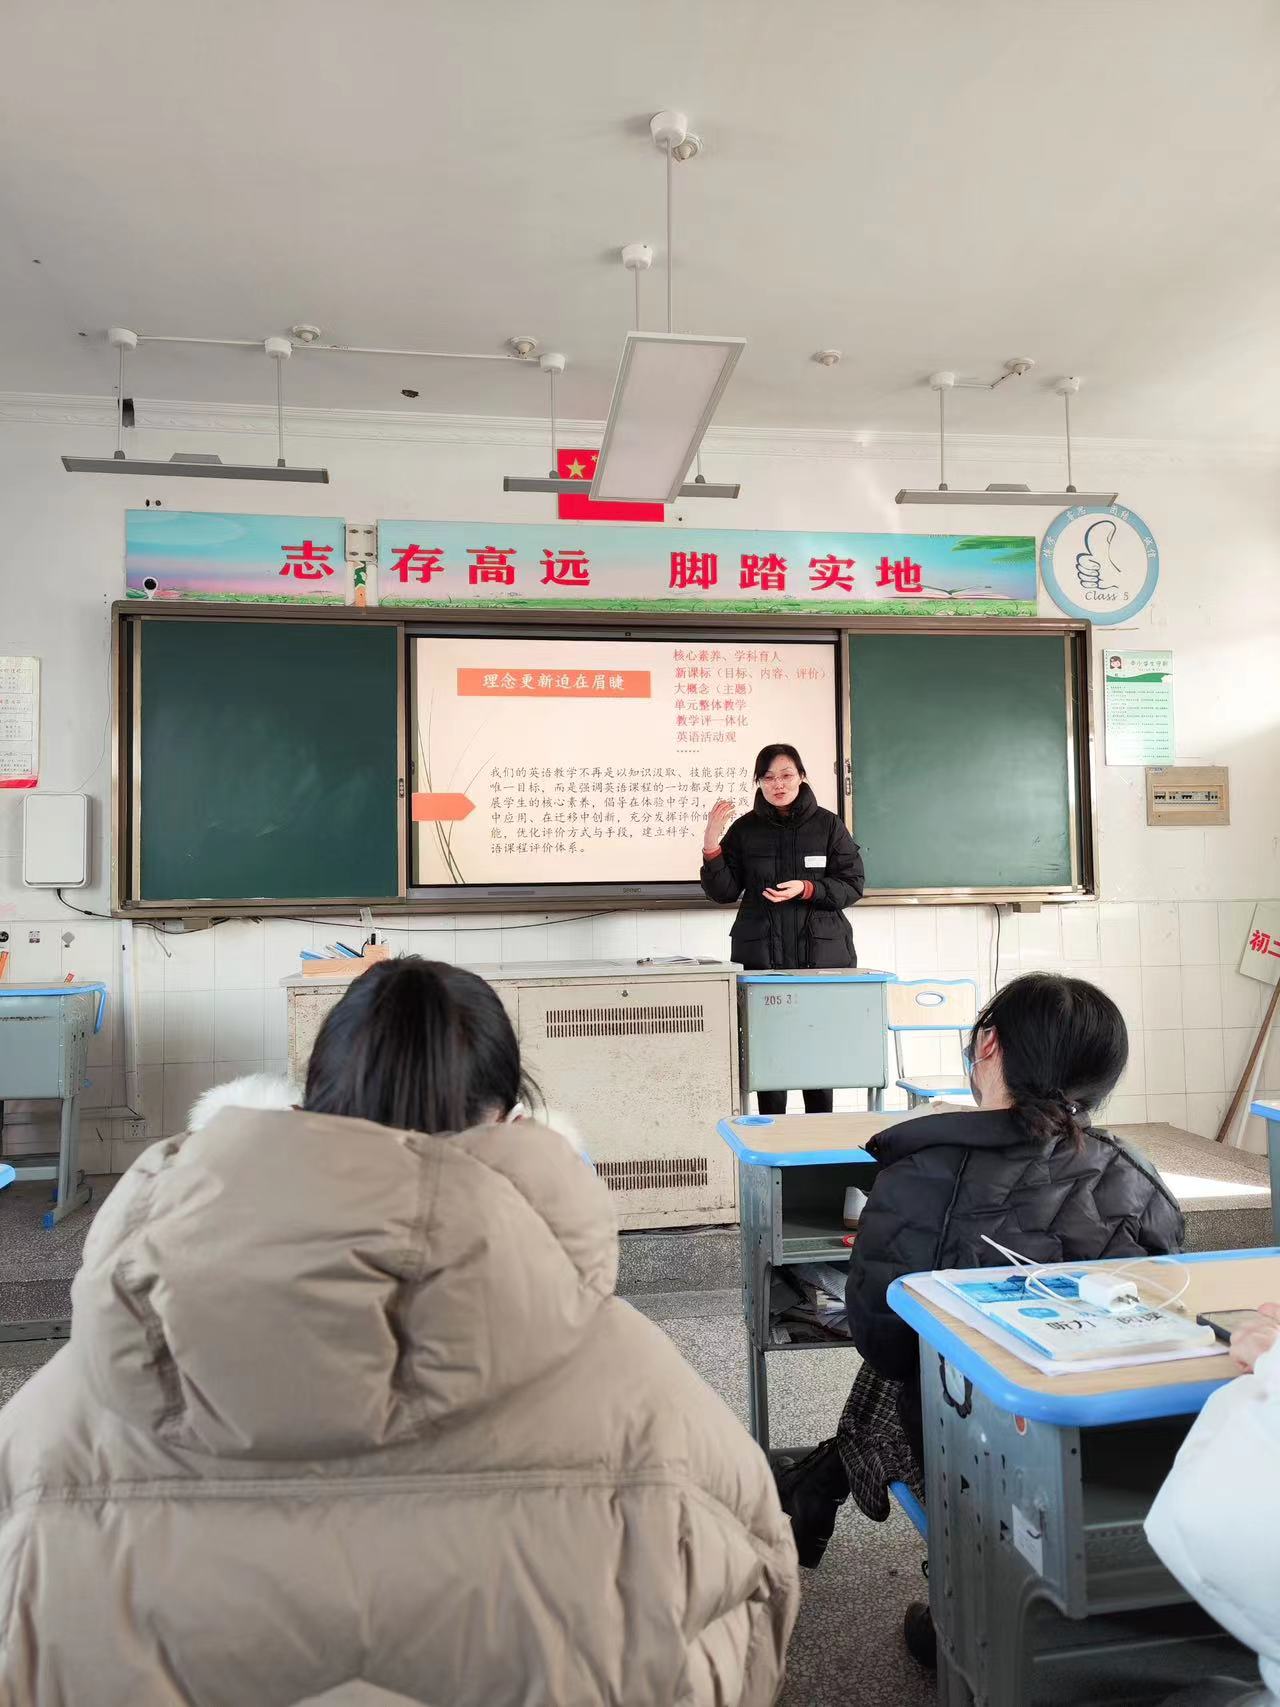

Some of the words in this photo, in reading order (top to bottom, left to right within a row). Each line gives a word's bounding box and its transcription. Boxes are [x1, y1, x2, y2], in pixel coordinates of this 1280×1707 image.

[280, 540, 591, 587] 志存高远
[669, 551, 923, 593] 脚踏实地
[1085, 590, 1117, 602] Class
[672, 648, 783, 663] 核心素养、学科育人
[482, 672, 625, 691] 理念更新迫在眉睫
[674, 682, 754, 695] 大概念（主题）
[675, 698, 747, 712] 单元整体教学
[676, 714, 748, 727] 教学评一体化
[677, 730, 737, 743] 英语活动观
[491, 841, 585, 854] 语课程评价体系。
[764, 995, 782, 1006] 205
